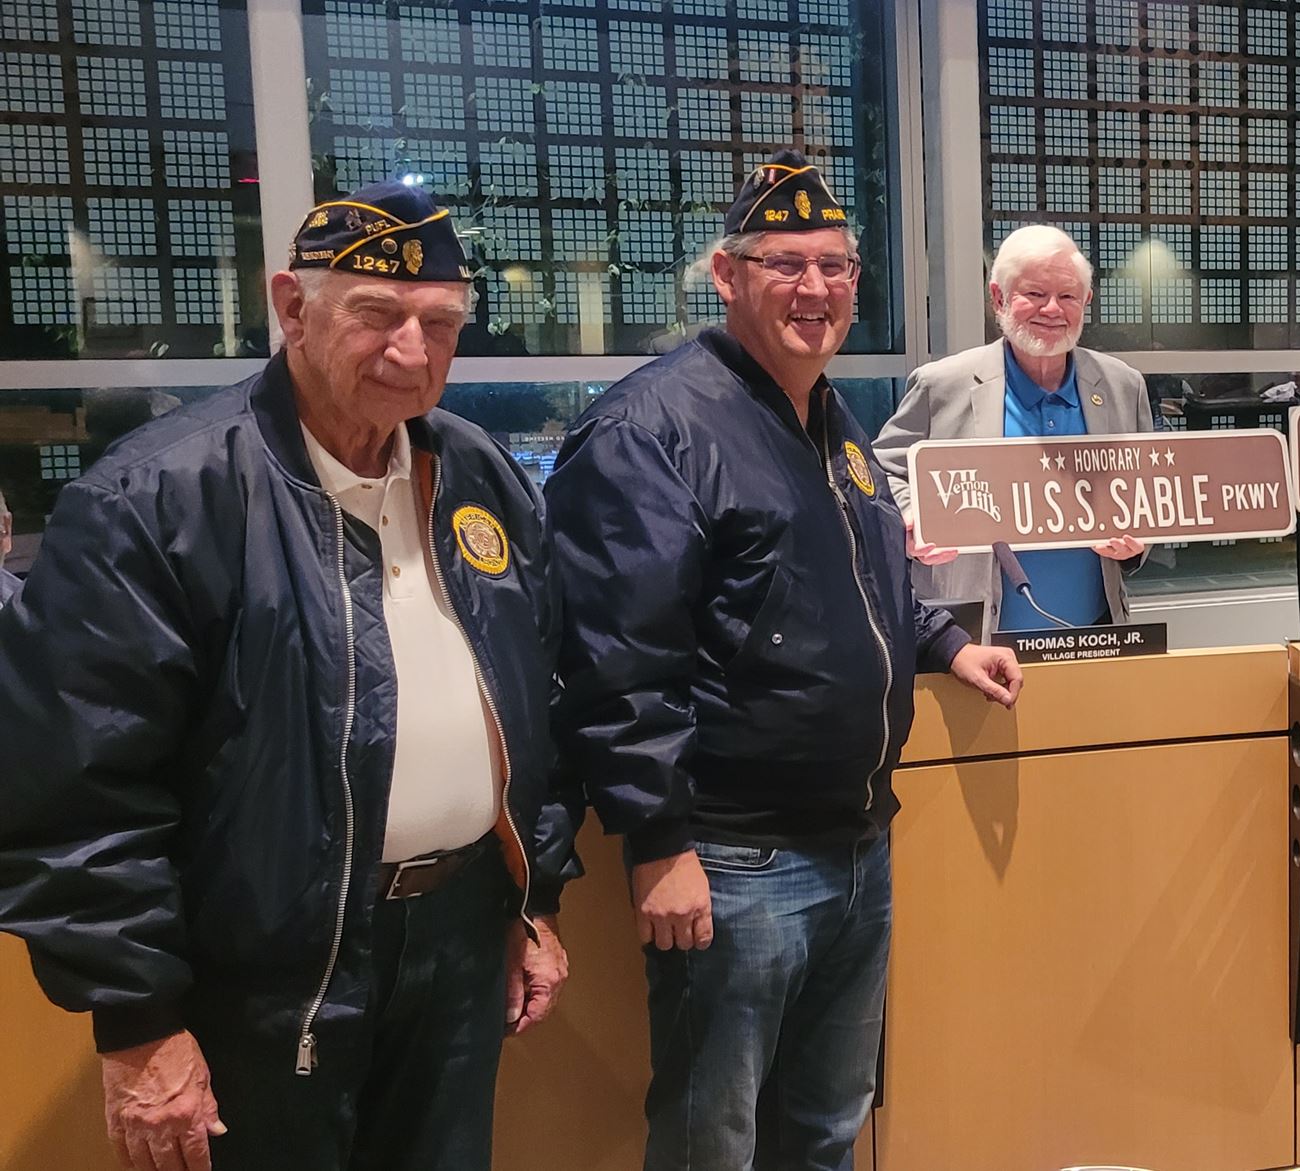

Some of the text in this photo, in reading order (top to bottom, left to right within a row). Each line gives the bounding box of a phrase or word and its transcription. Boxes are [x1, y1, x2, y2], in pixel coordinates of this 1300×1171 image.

[764, 209, 789, 222] 1247
[353, 255, 400, 274] 1247
[1074, 447, 1140, 473] HONORARY
[928, 469, 990, 509] Vernon
[955, 478, 1002, 522] Hills
[1011, 475, 1280, 535] U.S.S. SABLE PKWY
[1017, 632, 1144, 651] THOMAS KOCH, JR.
[1042, 649, 1120, 661] VILLAGE PRESIDENT
